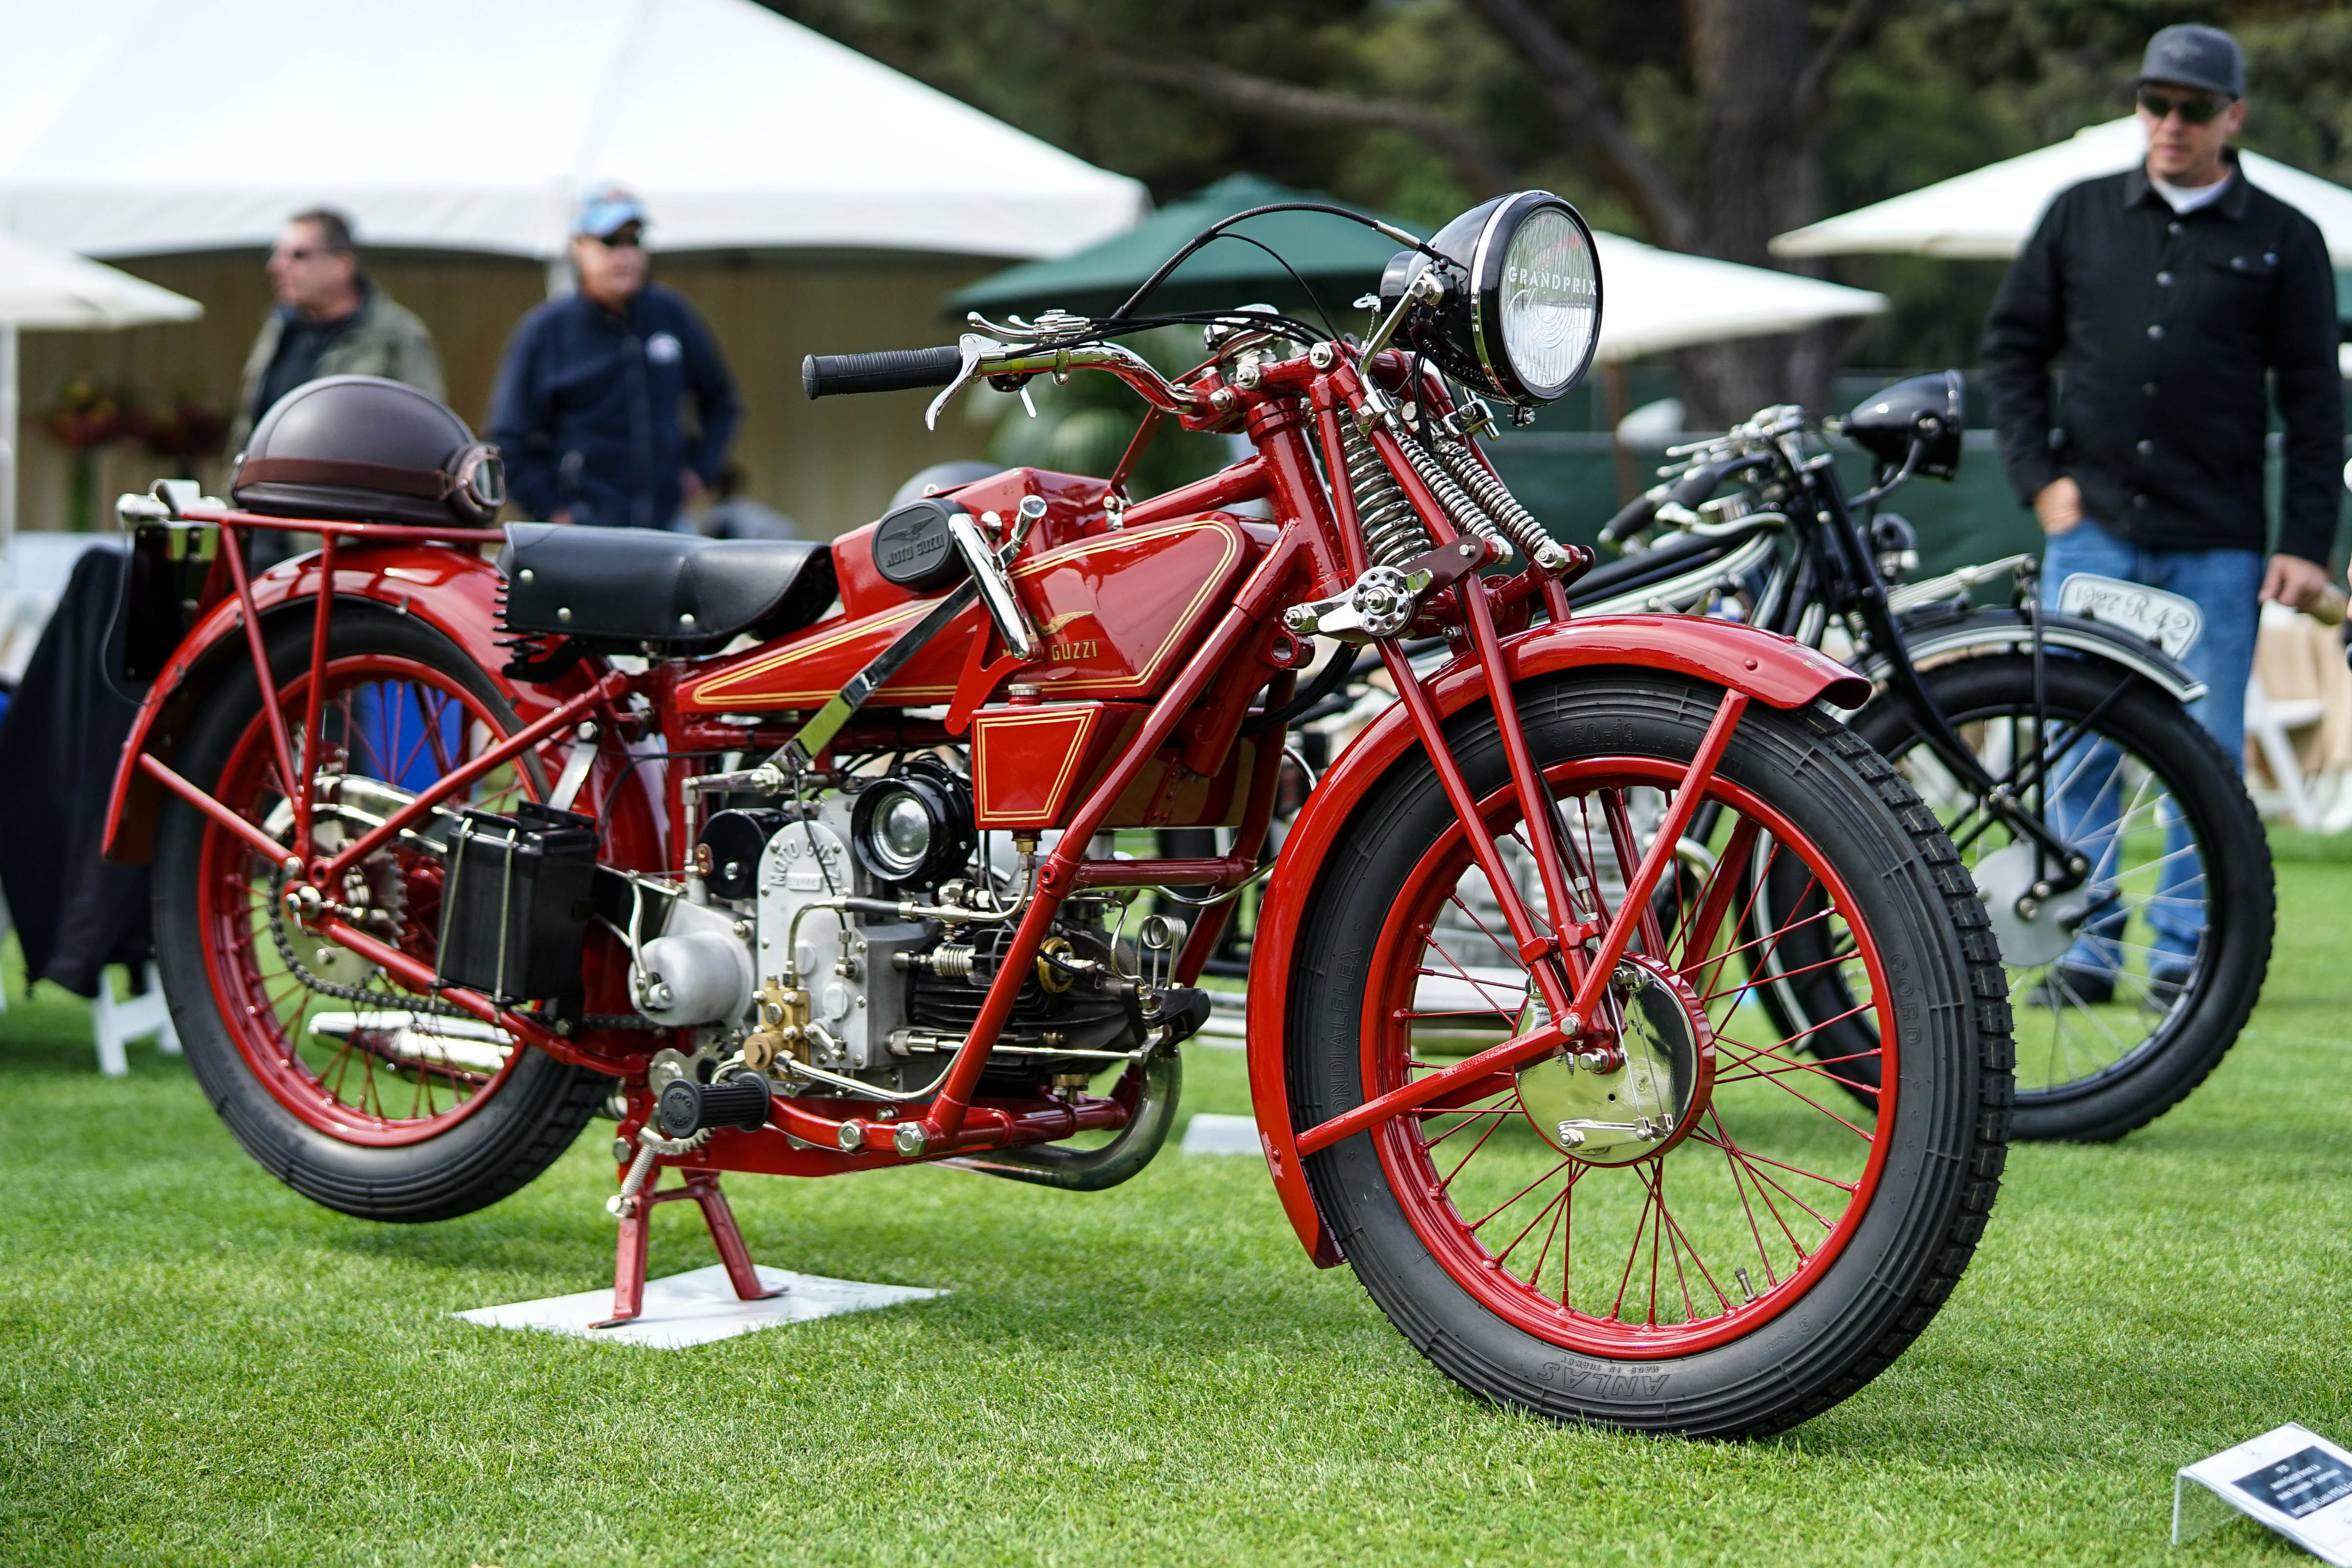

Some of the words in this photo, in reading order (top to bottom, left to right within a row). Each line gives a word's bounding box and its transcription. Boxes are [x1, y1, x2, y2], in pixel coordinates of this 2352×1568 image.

[915, 533, 945, 556] GUZZI
[2123, 591, 2149, 624] R
[2150, 607, 2191, 642] 42
[1051, 640, 1098, 661] GUZZI
[769, 839, 799, 886] MOTO
[1890, 952, 1921, 1043] CORD
[1329, 947, 1362, 1116] ONDIALFLEX
[1538, 1362, 1669, 1396] ANLAS
[1560, 1356, 1601, 1371] TURKEY
[1631, 1366, 1660, 1374] MADE
